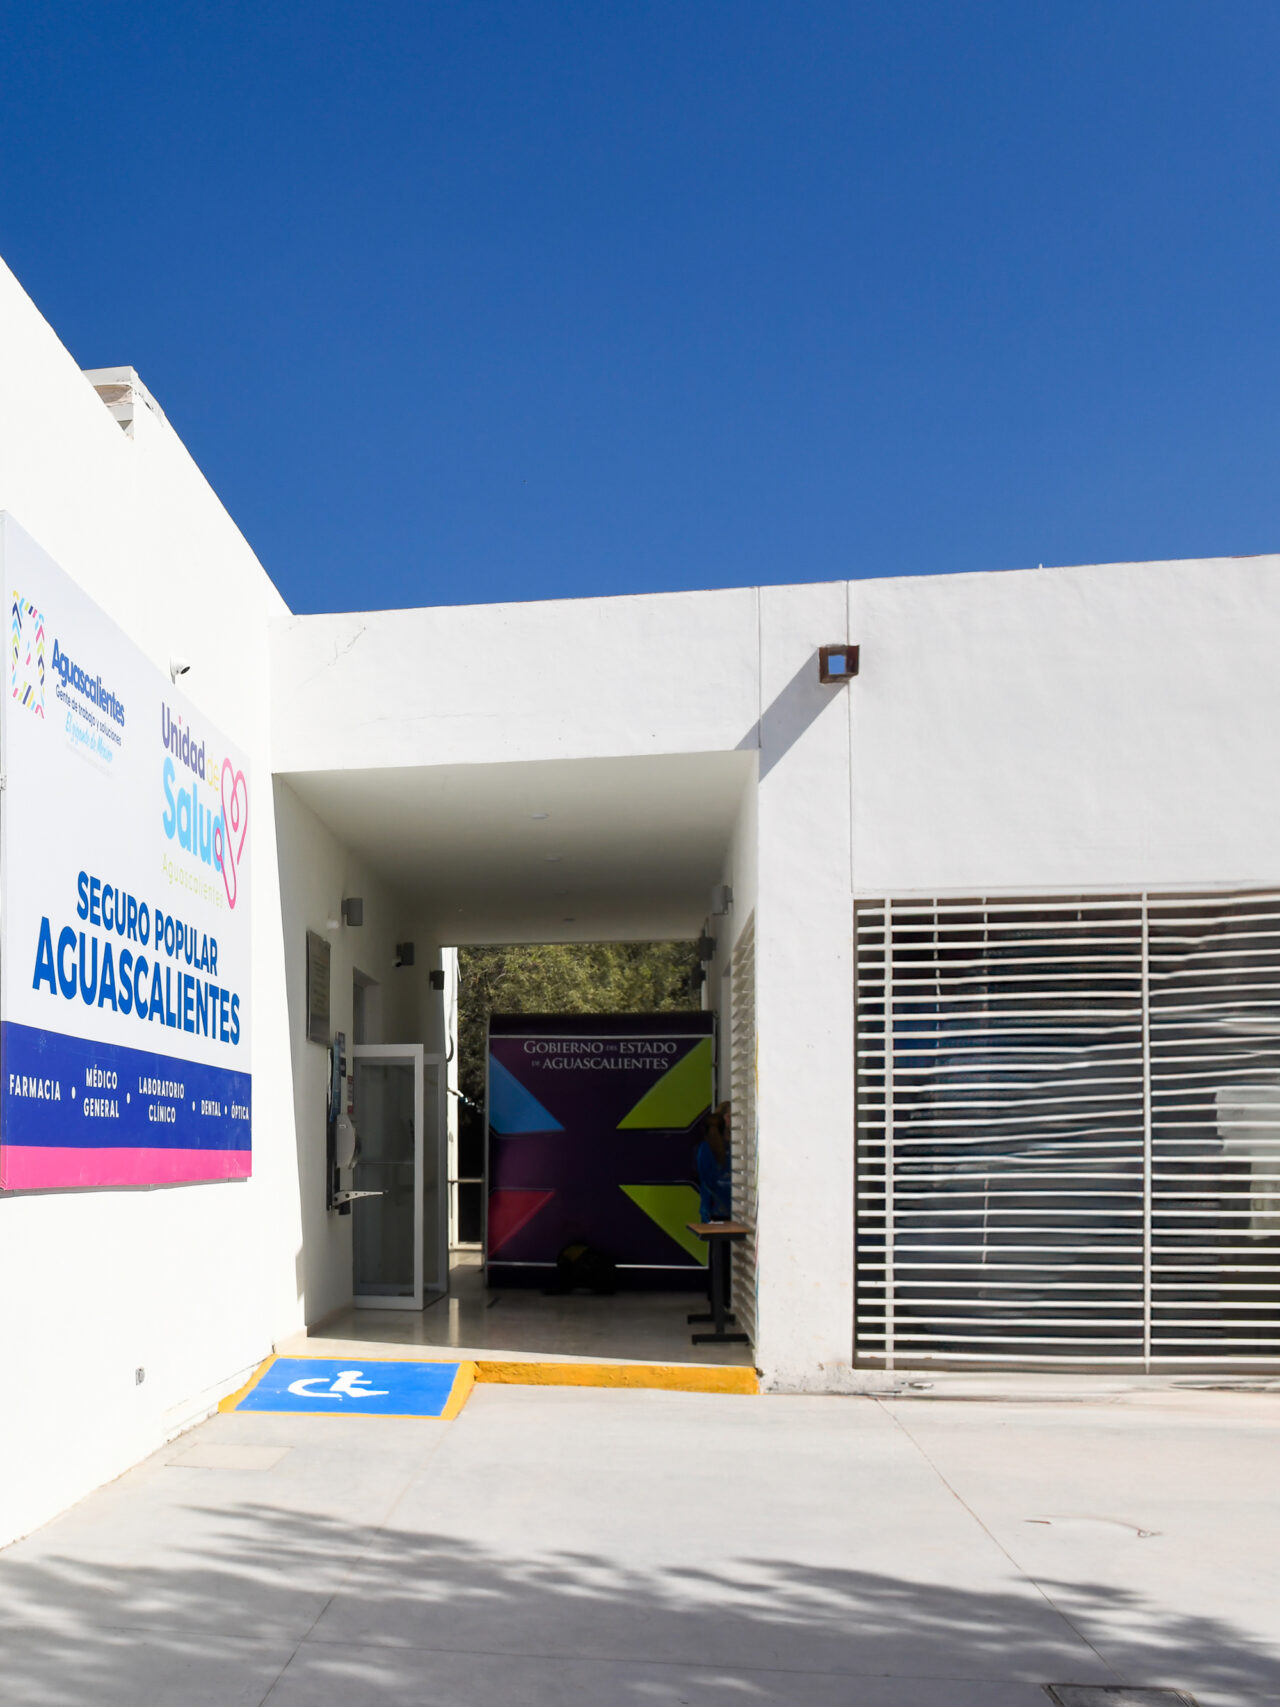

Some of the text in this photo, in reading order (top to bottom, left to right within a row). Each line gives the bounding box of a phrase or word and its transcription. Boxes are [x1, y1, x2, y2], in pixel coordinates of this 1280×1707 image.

[51, 638, 125, 727] Aguascalientes
[55, 684, 71, 707] Gente
[71, 697, 78, 712] de
[78, 702, 95, 727] trabajo
[99, 720, 122, 746] soluciones
[162, 701, 220, 792] Unidad de
[162, 757, 225, 874] Salud
[162, 853, 224, 909] Aguascalientes
[77, 870, 218, 976] SEGURO POPULAR
[32, 916, 240, 1045] AGUASCALIENTES
[523, 1040, 604, 1054] GOBIERNO
[620, 1042, 677, 1054] ESTADO
[542, 1057, 669, 1070] AGUASCALIENTES
[9, 1074, 61, 1101] FARMACIA
[86, 1064, 118, 1090] MÉDICO
[138, 1076, 185, 1100] LABORATORIO
[83, 1098, 119, 1118] GENERAL
[148, 1104, 176, 1123] CLÍNICO
[201, 1100, 222, 1116] DENTAL
[231, 1100, 250, 1121] ÓPTICA
